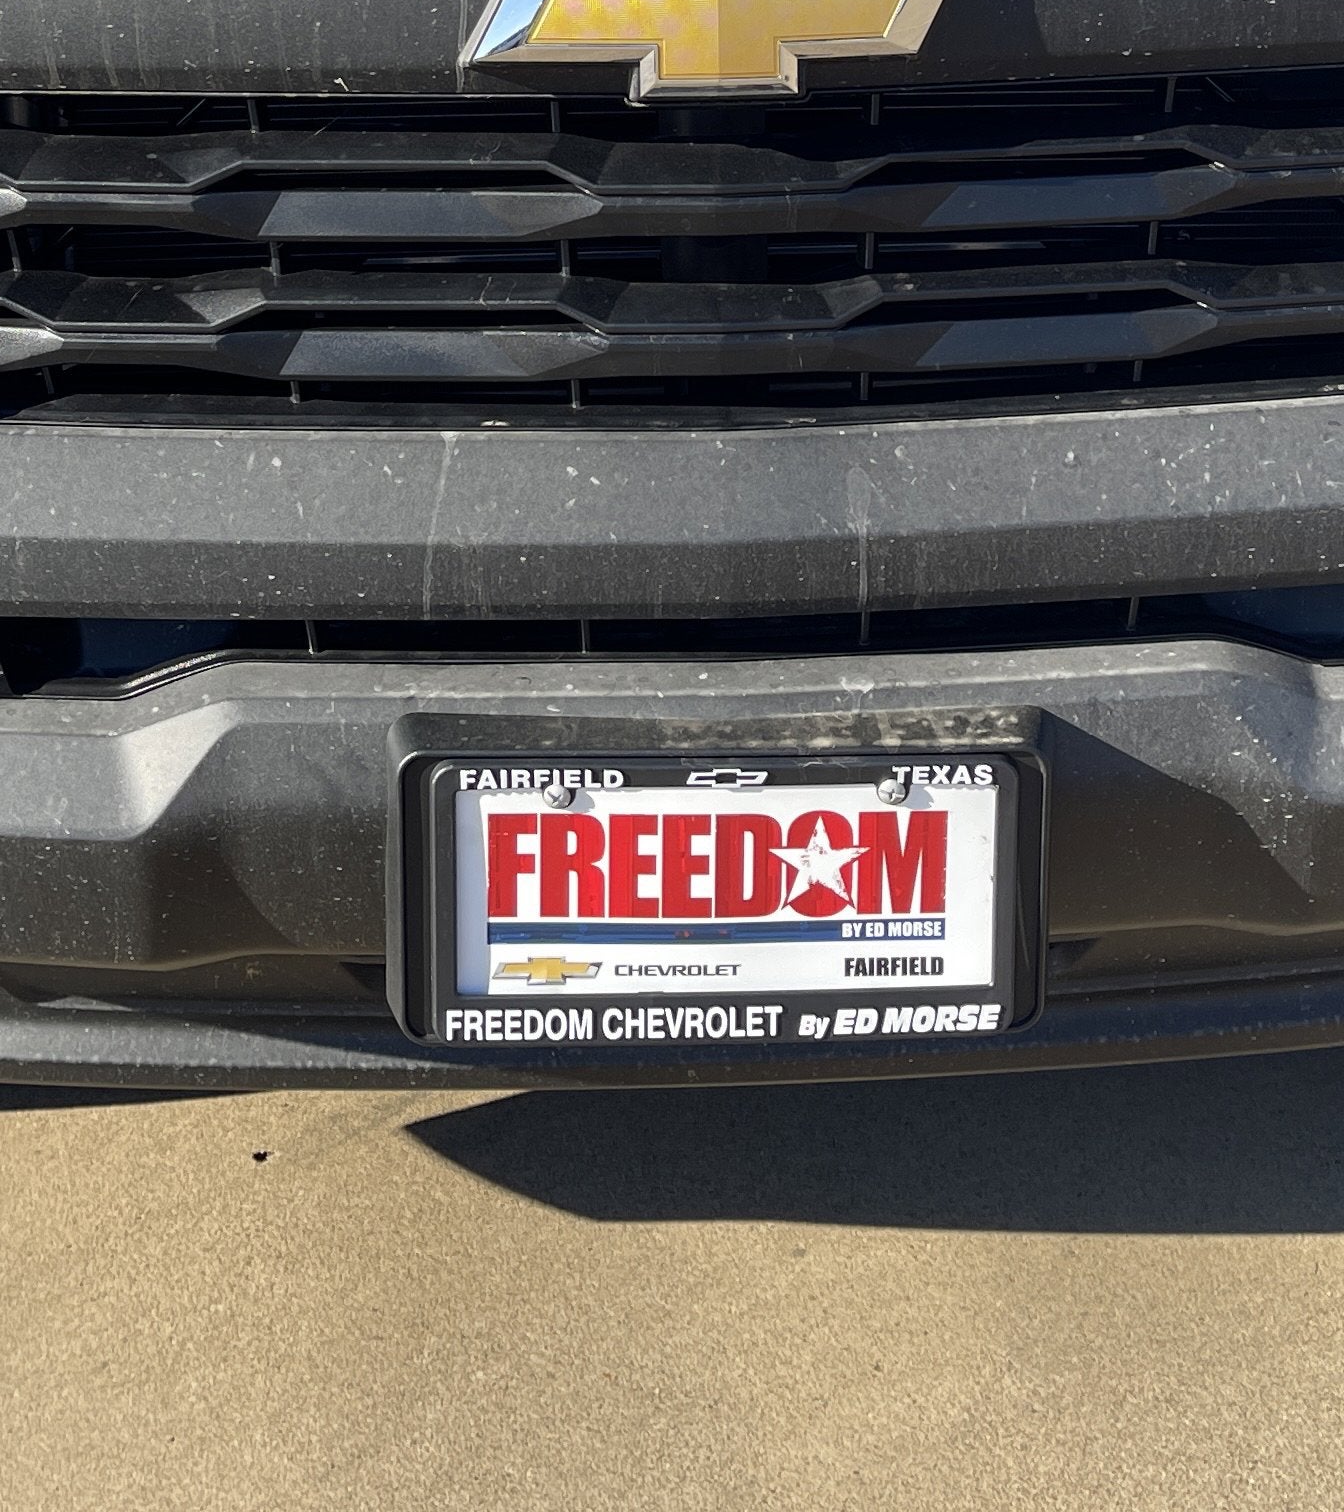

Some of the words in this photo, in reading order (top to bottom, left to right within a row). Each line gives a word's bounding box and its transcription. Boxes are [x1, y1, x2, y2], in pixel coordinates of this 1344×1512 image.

[459, 768, 625, 789] FAIRFIELD
[892, 764, 994, 786] TEXAS
[487, 810, 949, 918] FREEDOM
[841, 921, 863, 937] BY
[865, 921, 885, 937] ED
[886, 920, 942, 937] MORSE
[614, 963, 742, 977] CHEVROLET
[844, 956, 945, 977] FAIRFIELD
[445, 1007, 594, 1041] FREEDOM
[601, 1004, 783, 1039] CHEVROLET
[798, 1014, 829, 1038] By
[833, 1009, 877, 1035] ED
[882, 1004, 1001, 1032] MORSE
